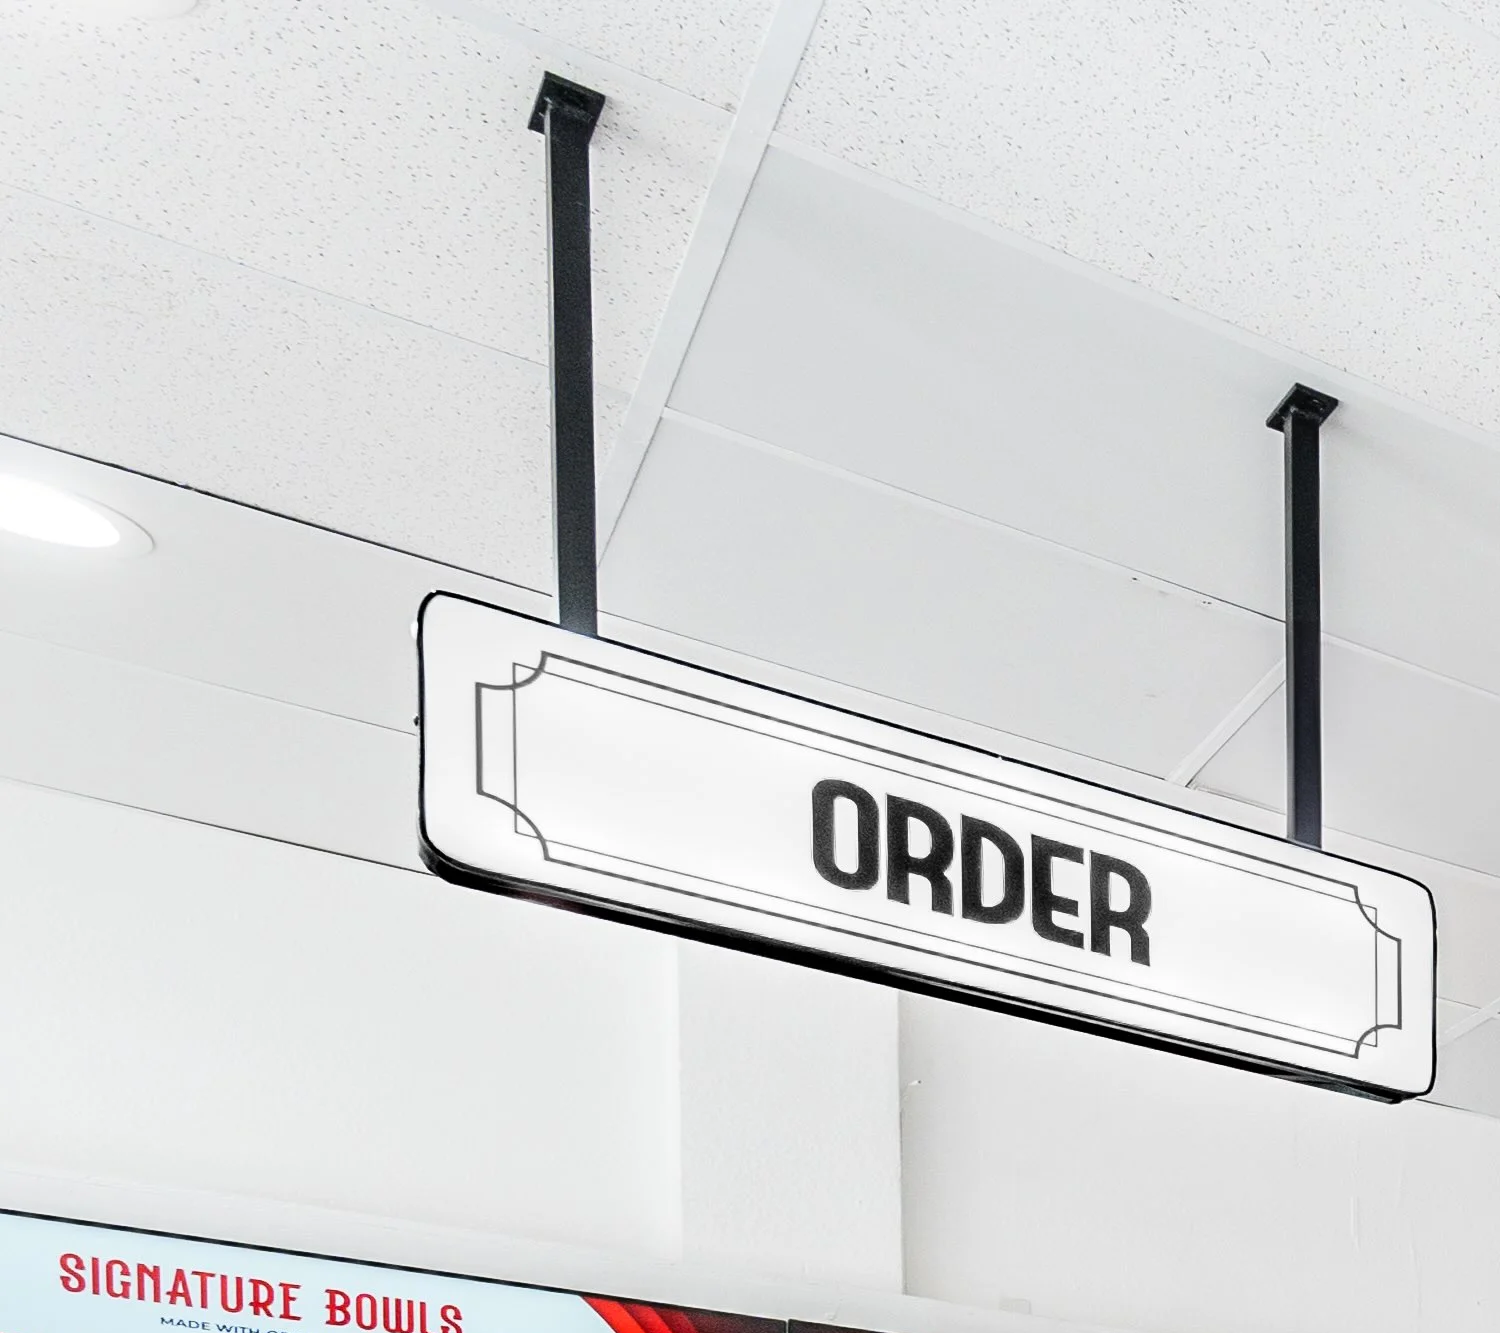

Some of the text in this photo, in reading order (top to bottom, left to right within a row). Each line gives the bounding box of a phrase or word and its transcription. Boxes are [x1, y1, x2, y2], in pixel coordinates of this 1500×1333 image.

[811, 778, 1151, 967] ORDER
[60, 1253, 302, 1320] SIGNATURE
[161, 1317, 210, 1331] MADE
